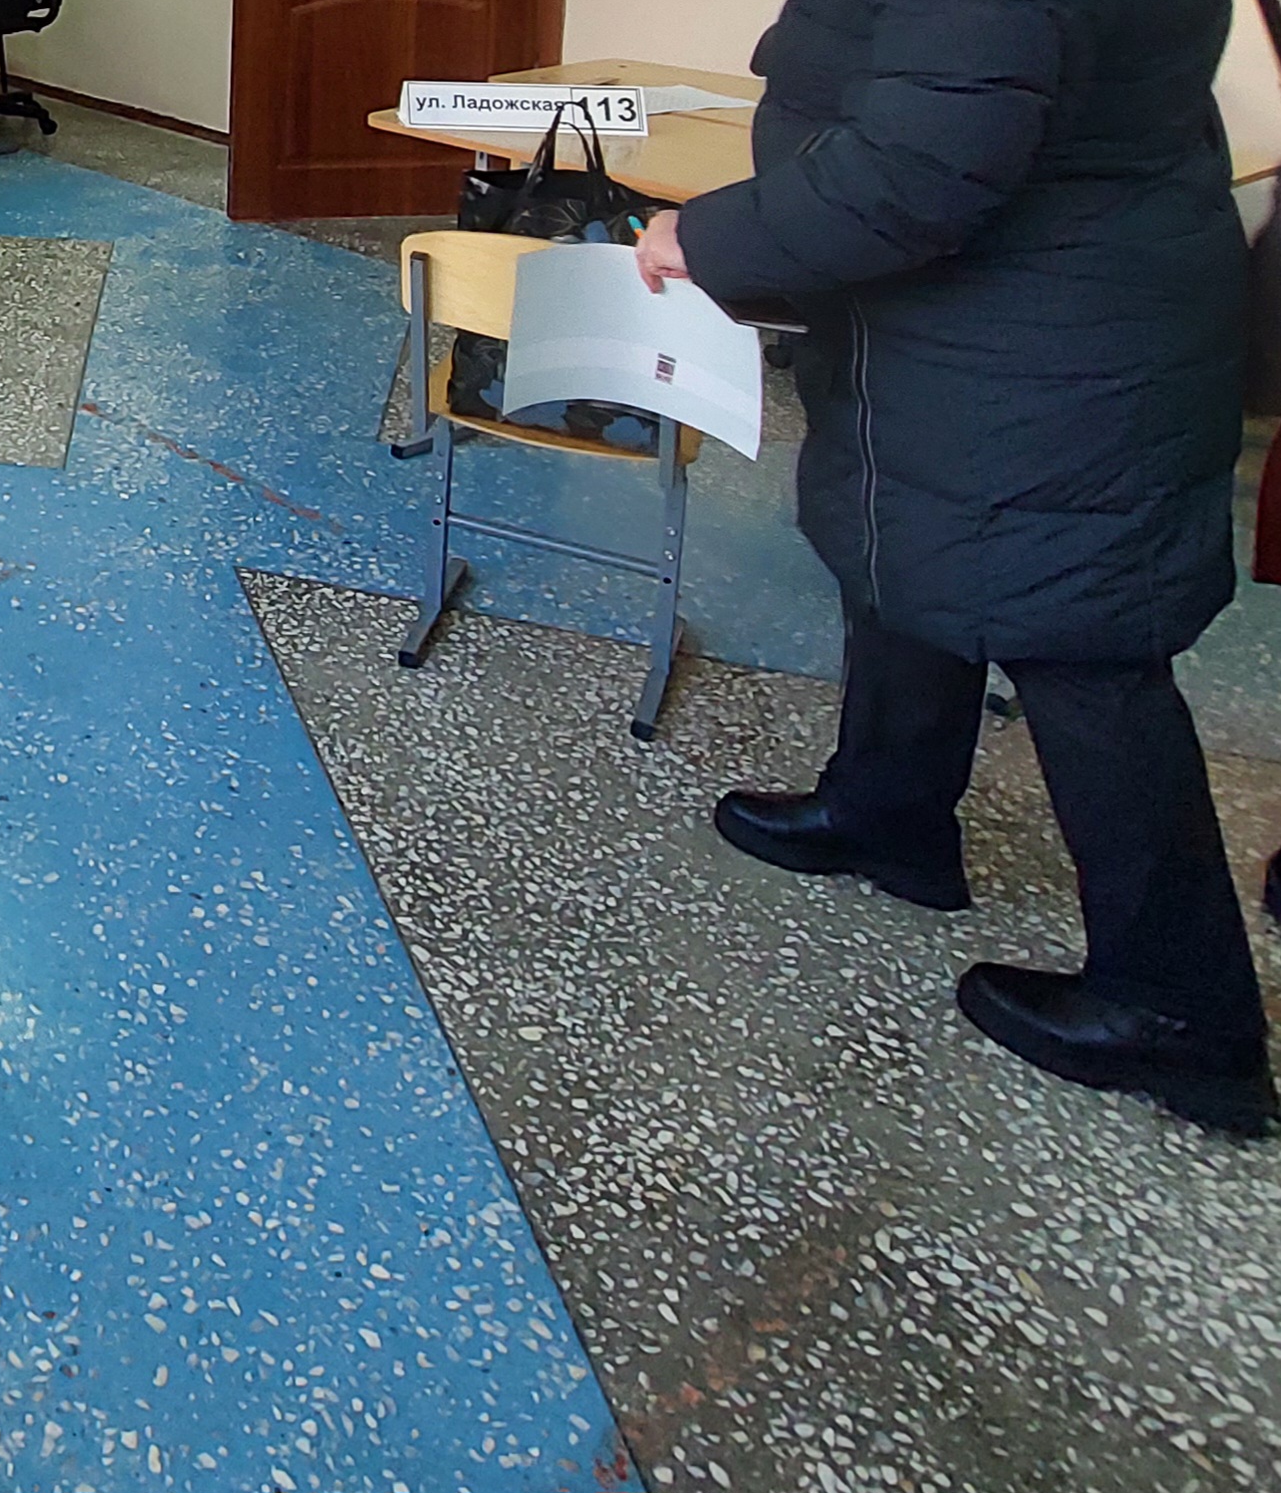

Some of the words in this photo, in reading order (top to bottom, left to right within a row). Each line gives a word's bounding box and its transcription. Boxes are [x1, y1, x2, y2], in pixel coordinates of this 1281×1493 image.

[416, 96, 446, 111] ул.
[452, 94, 565, 112] Ладожская
[579, 96, 637, 123] 113
